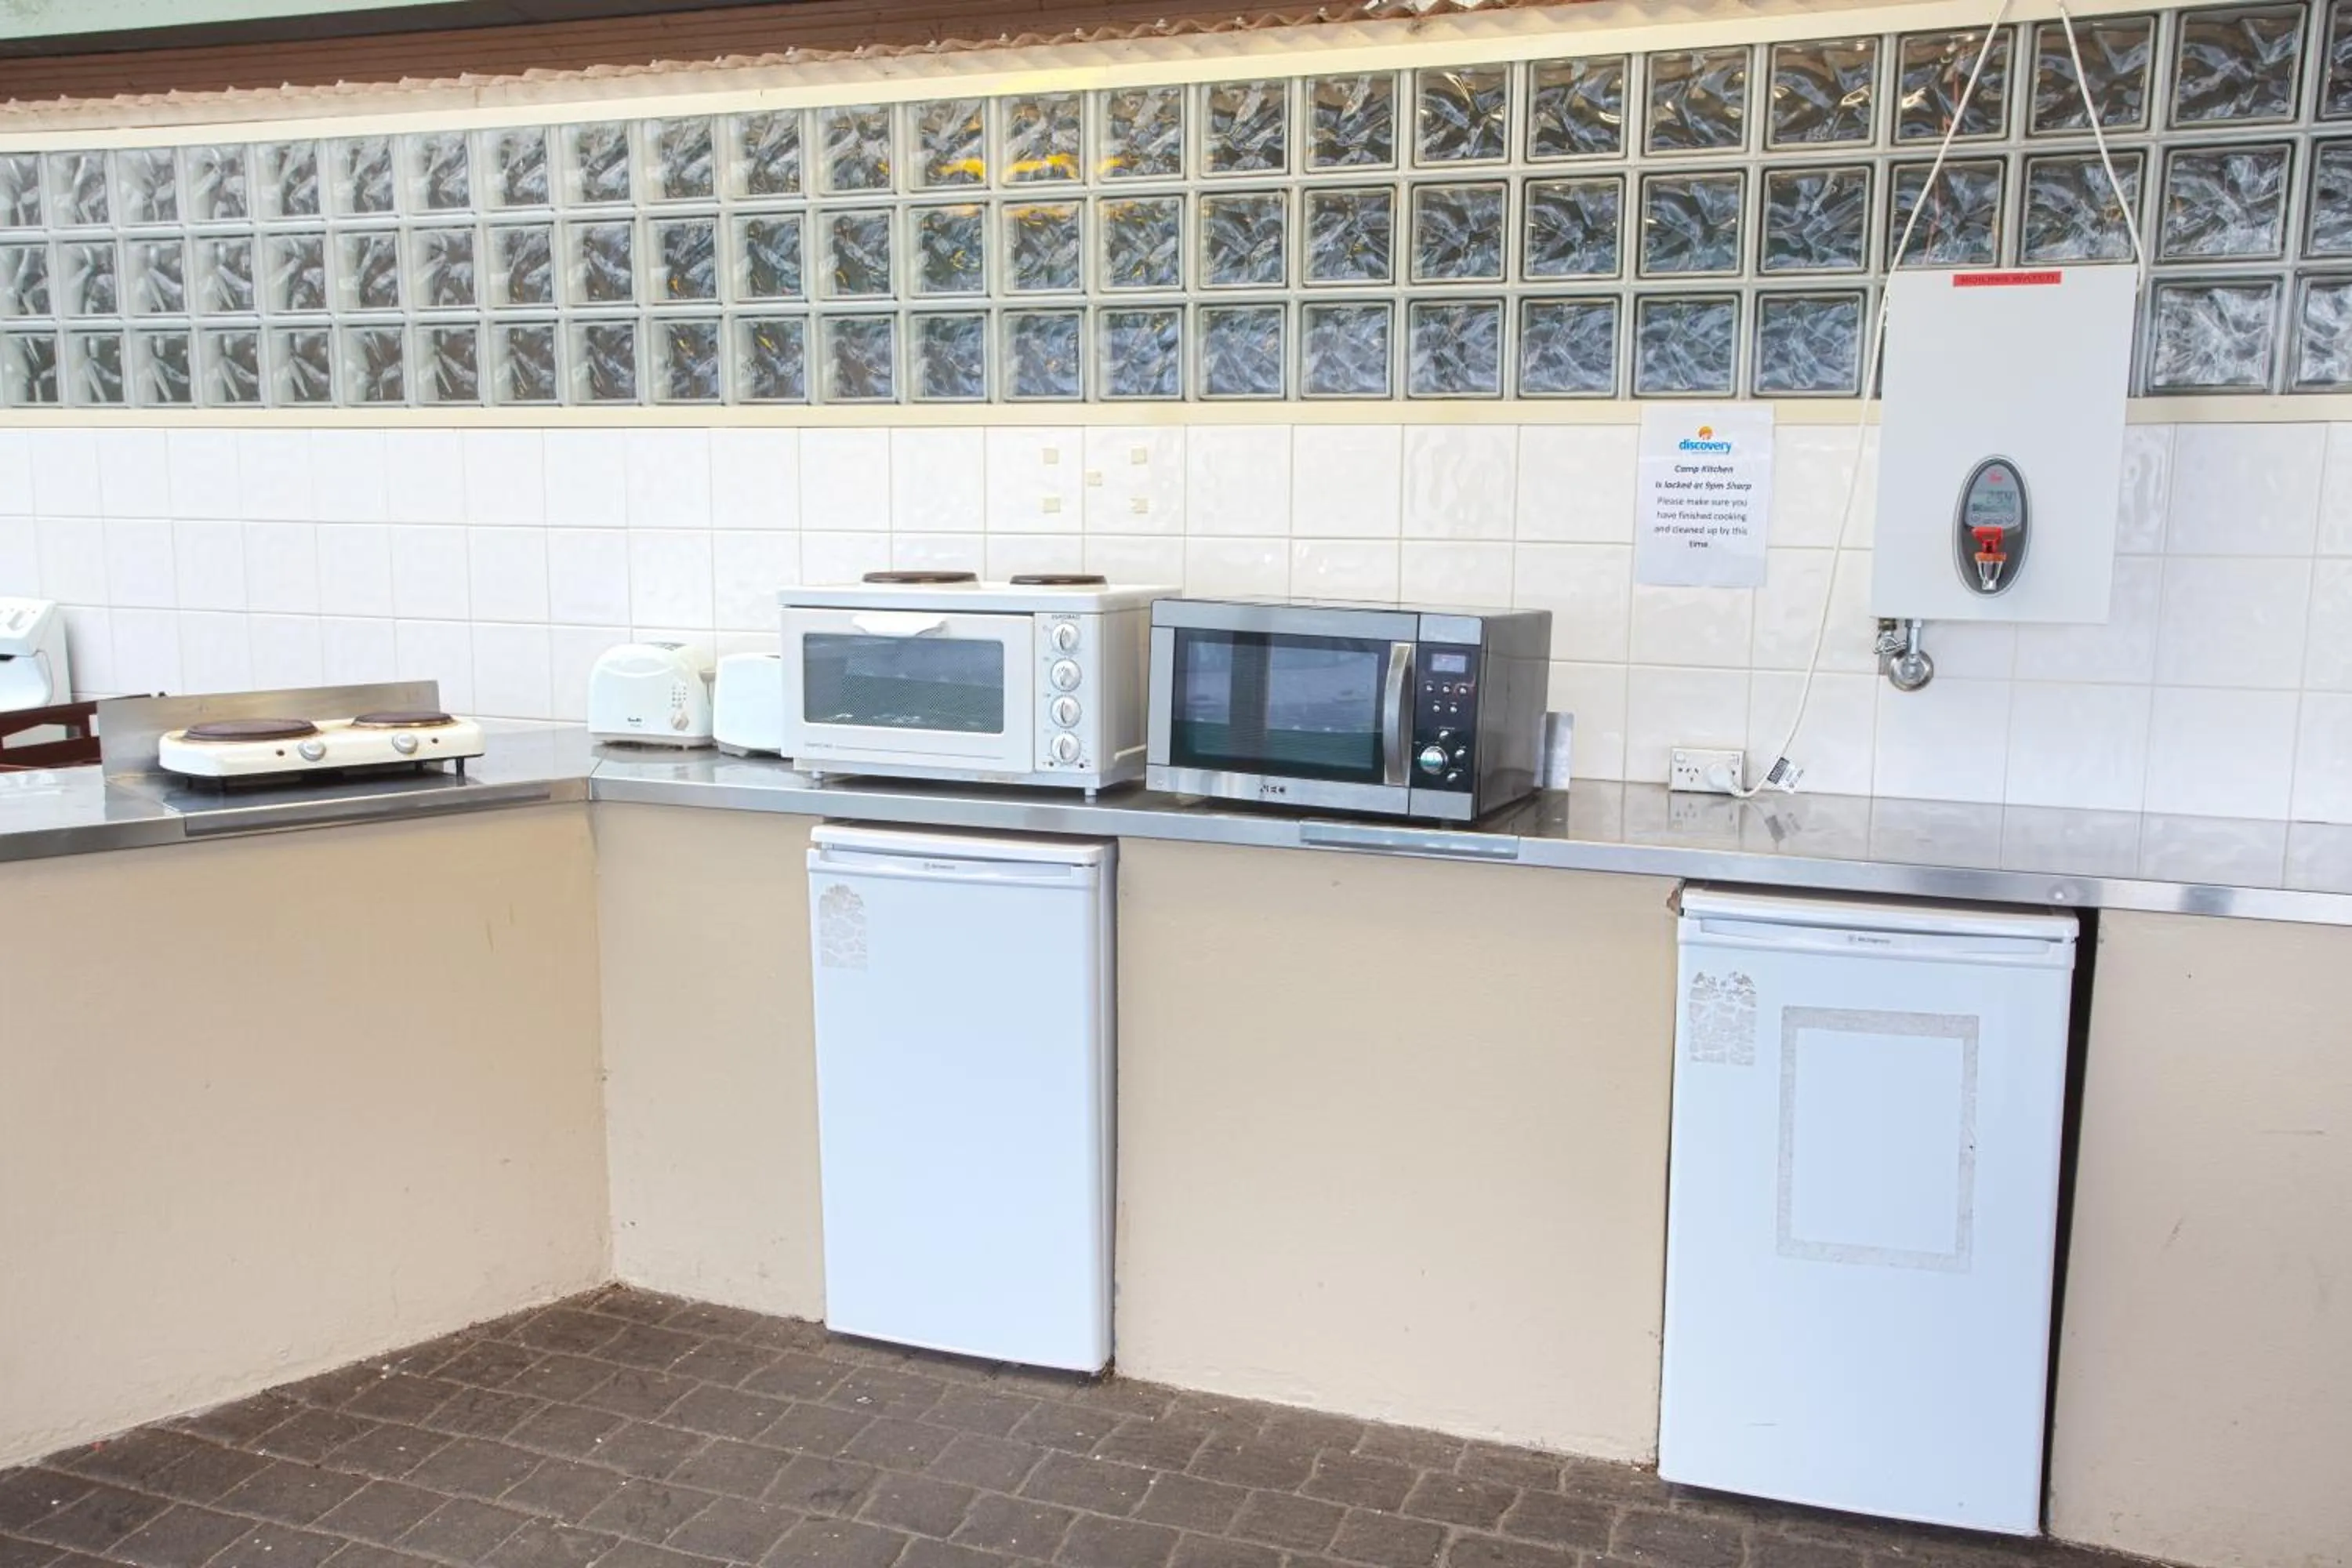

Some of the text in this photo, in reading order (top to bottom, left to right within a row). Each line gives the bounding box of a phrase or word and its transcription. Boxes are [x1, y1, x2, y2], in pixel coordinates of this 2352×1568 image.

[1679, 438, 1732, 455] discovery
[1674, 465, 1733, 474] Camp Kitchen
[1664, 481, 1692, 489] locked
[1705, 481, 1724, 491] 9pm
[1726, 481, 1752, 492] Sharp
[1657, 495, 1684, 505] Please
[1686, 496, 1709, 506] make
[1731, 499, 1748, 508] you
[1657, 510, 1747, 522] have finished cooking
[1653, 524, 1670, 533] and
[1719, 526, 1730, 535] by
[1732, 526, 1748, 535] this
